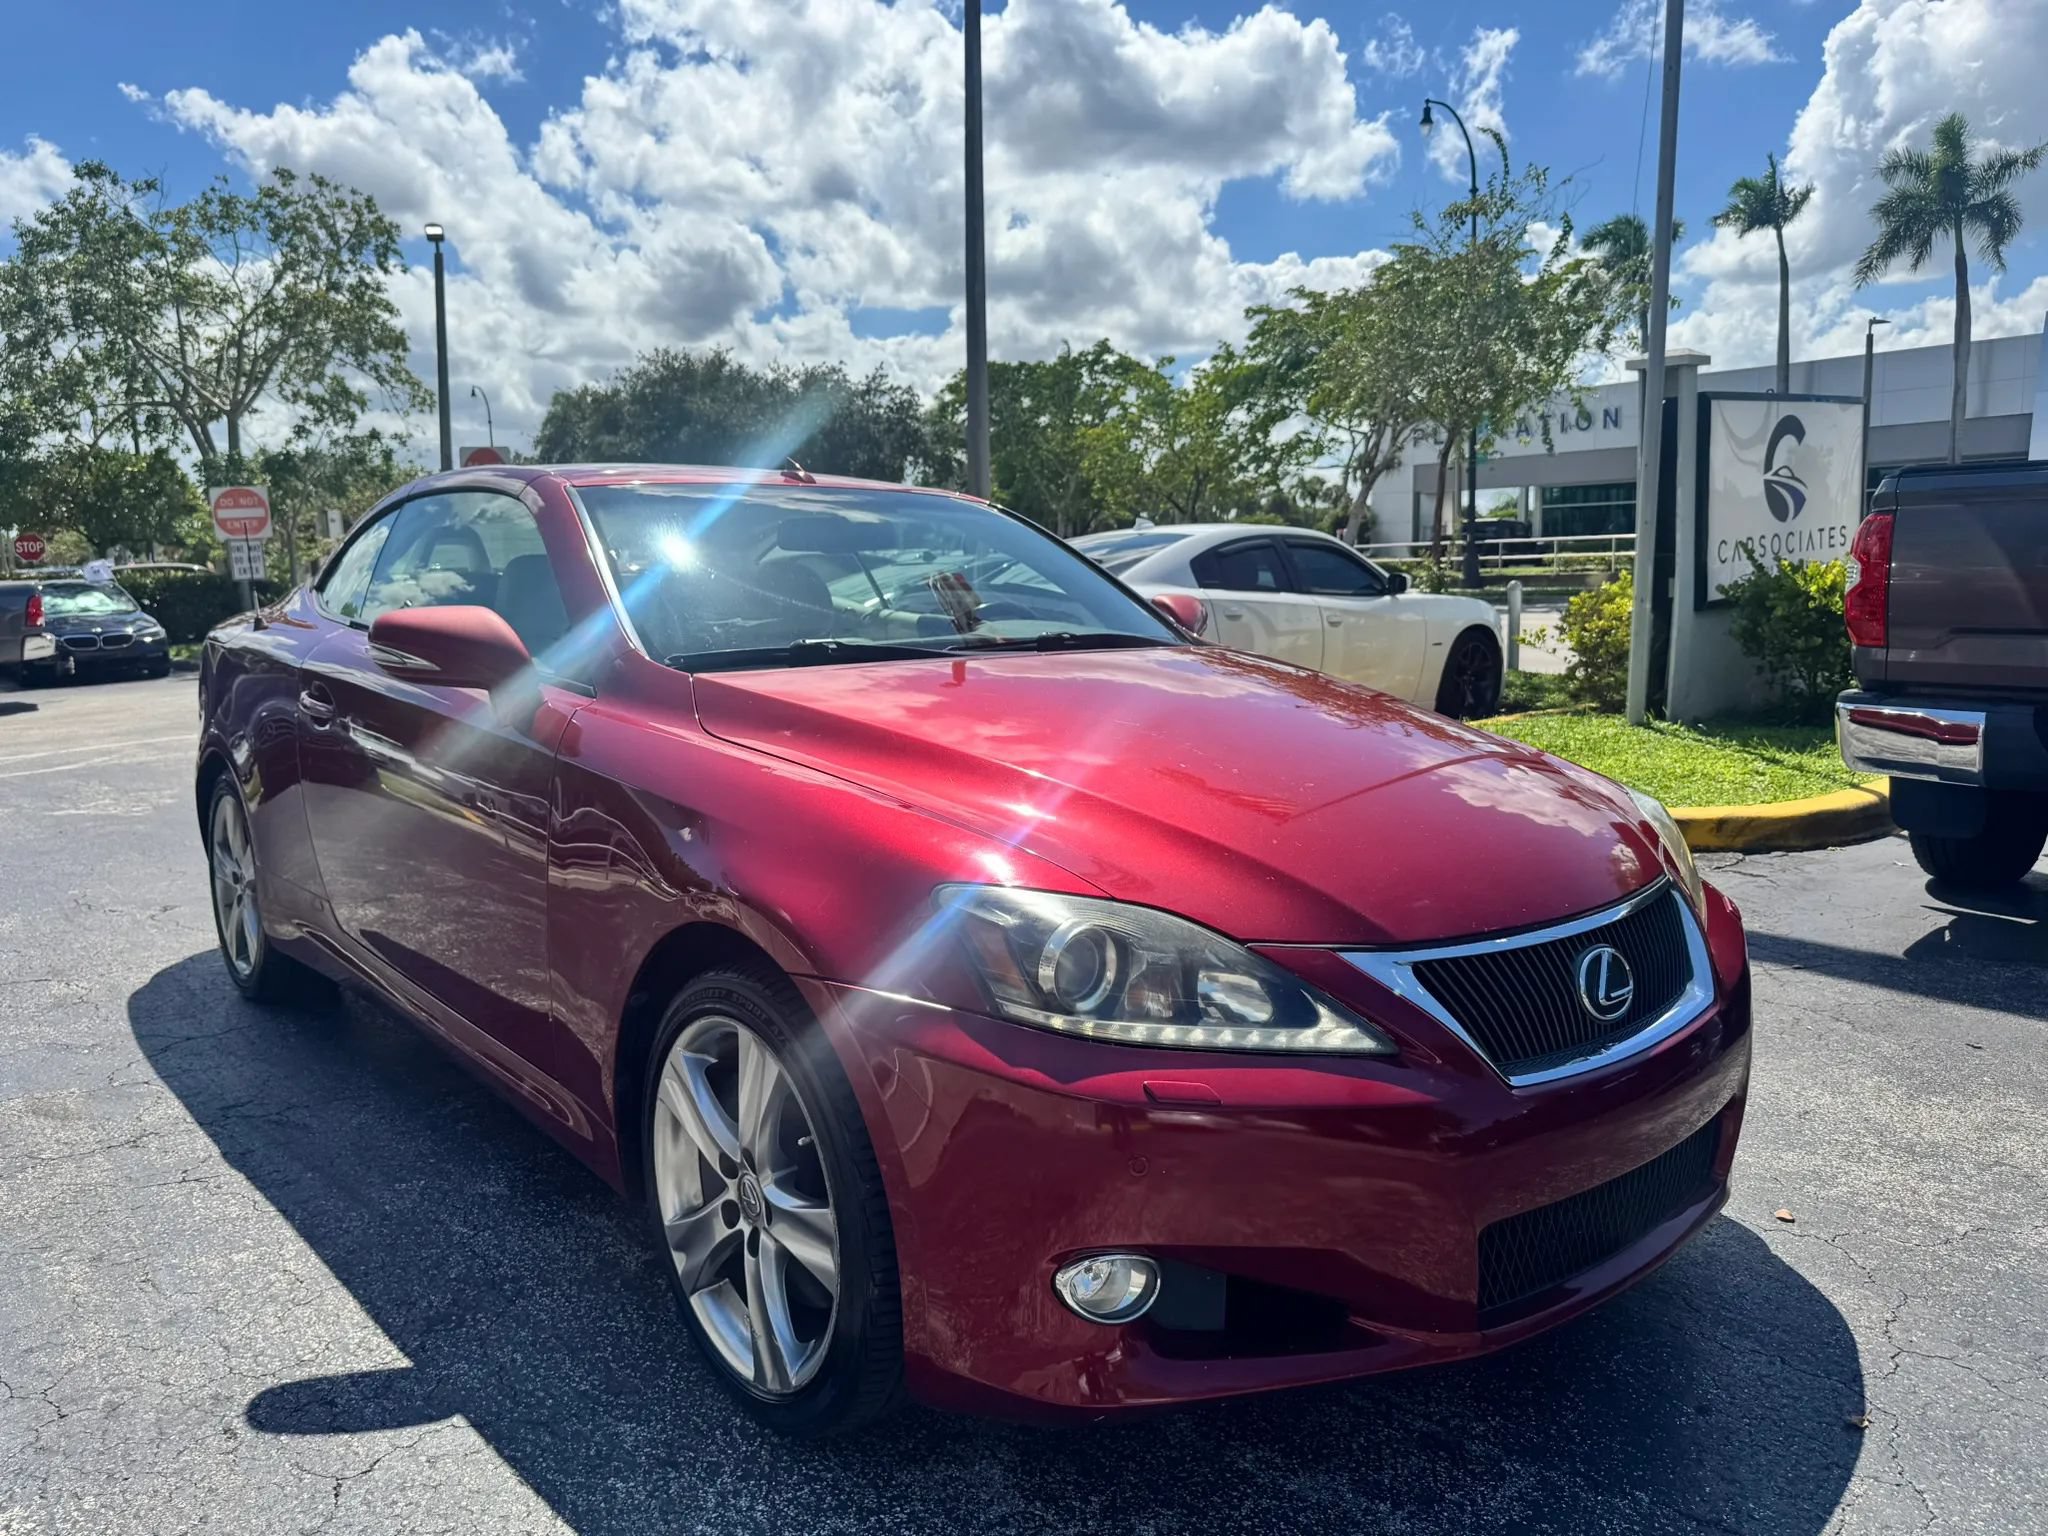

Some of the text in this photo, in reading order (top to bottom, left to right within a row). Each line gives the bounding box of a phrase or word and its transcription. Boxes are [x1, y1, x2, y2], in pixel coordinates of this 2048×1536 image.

[219, 496, 259, 507] DO NOT
[226, 519, 259, 529] ENTER
[15, 540, 44, 553] STOP
[238, 566, 260, 576] ENTR
